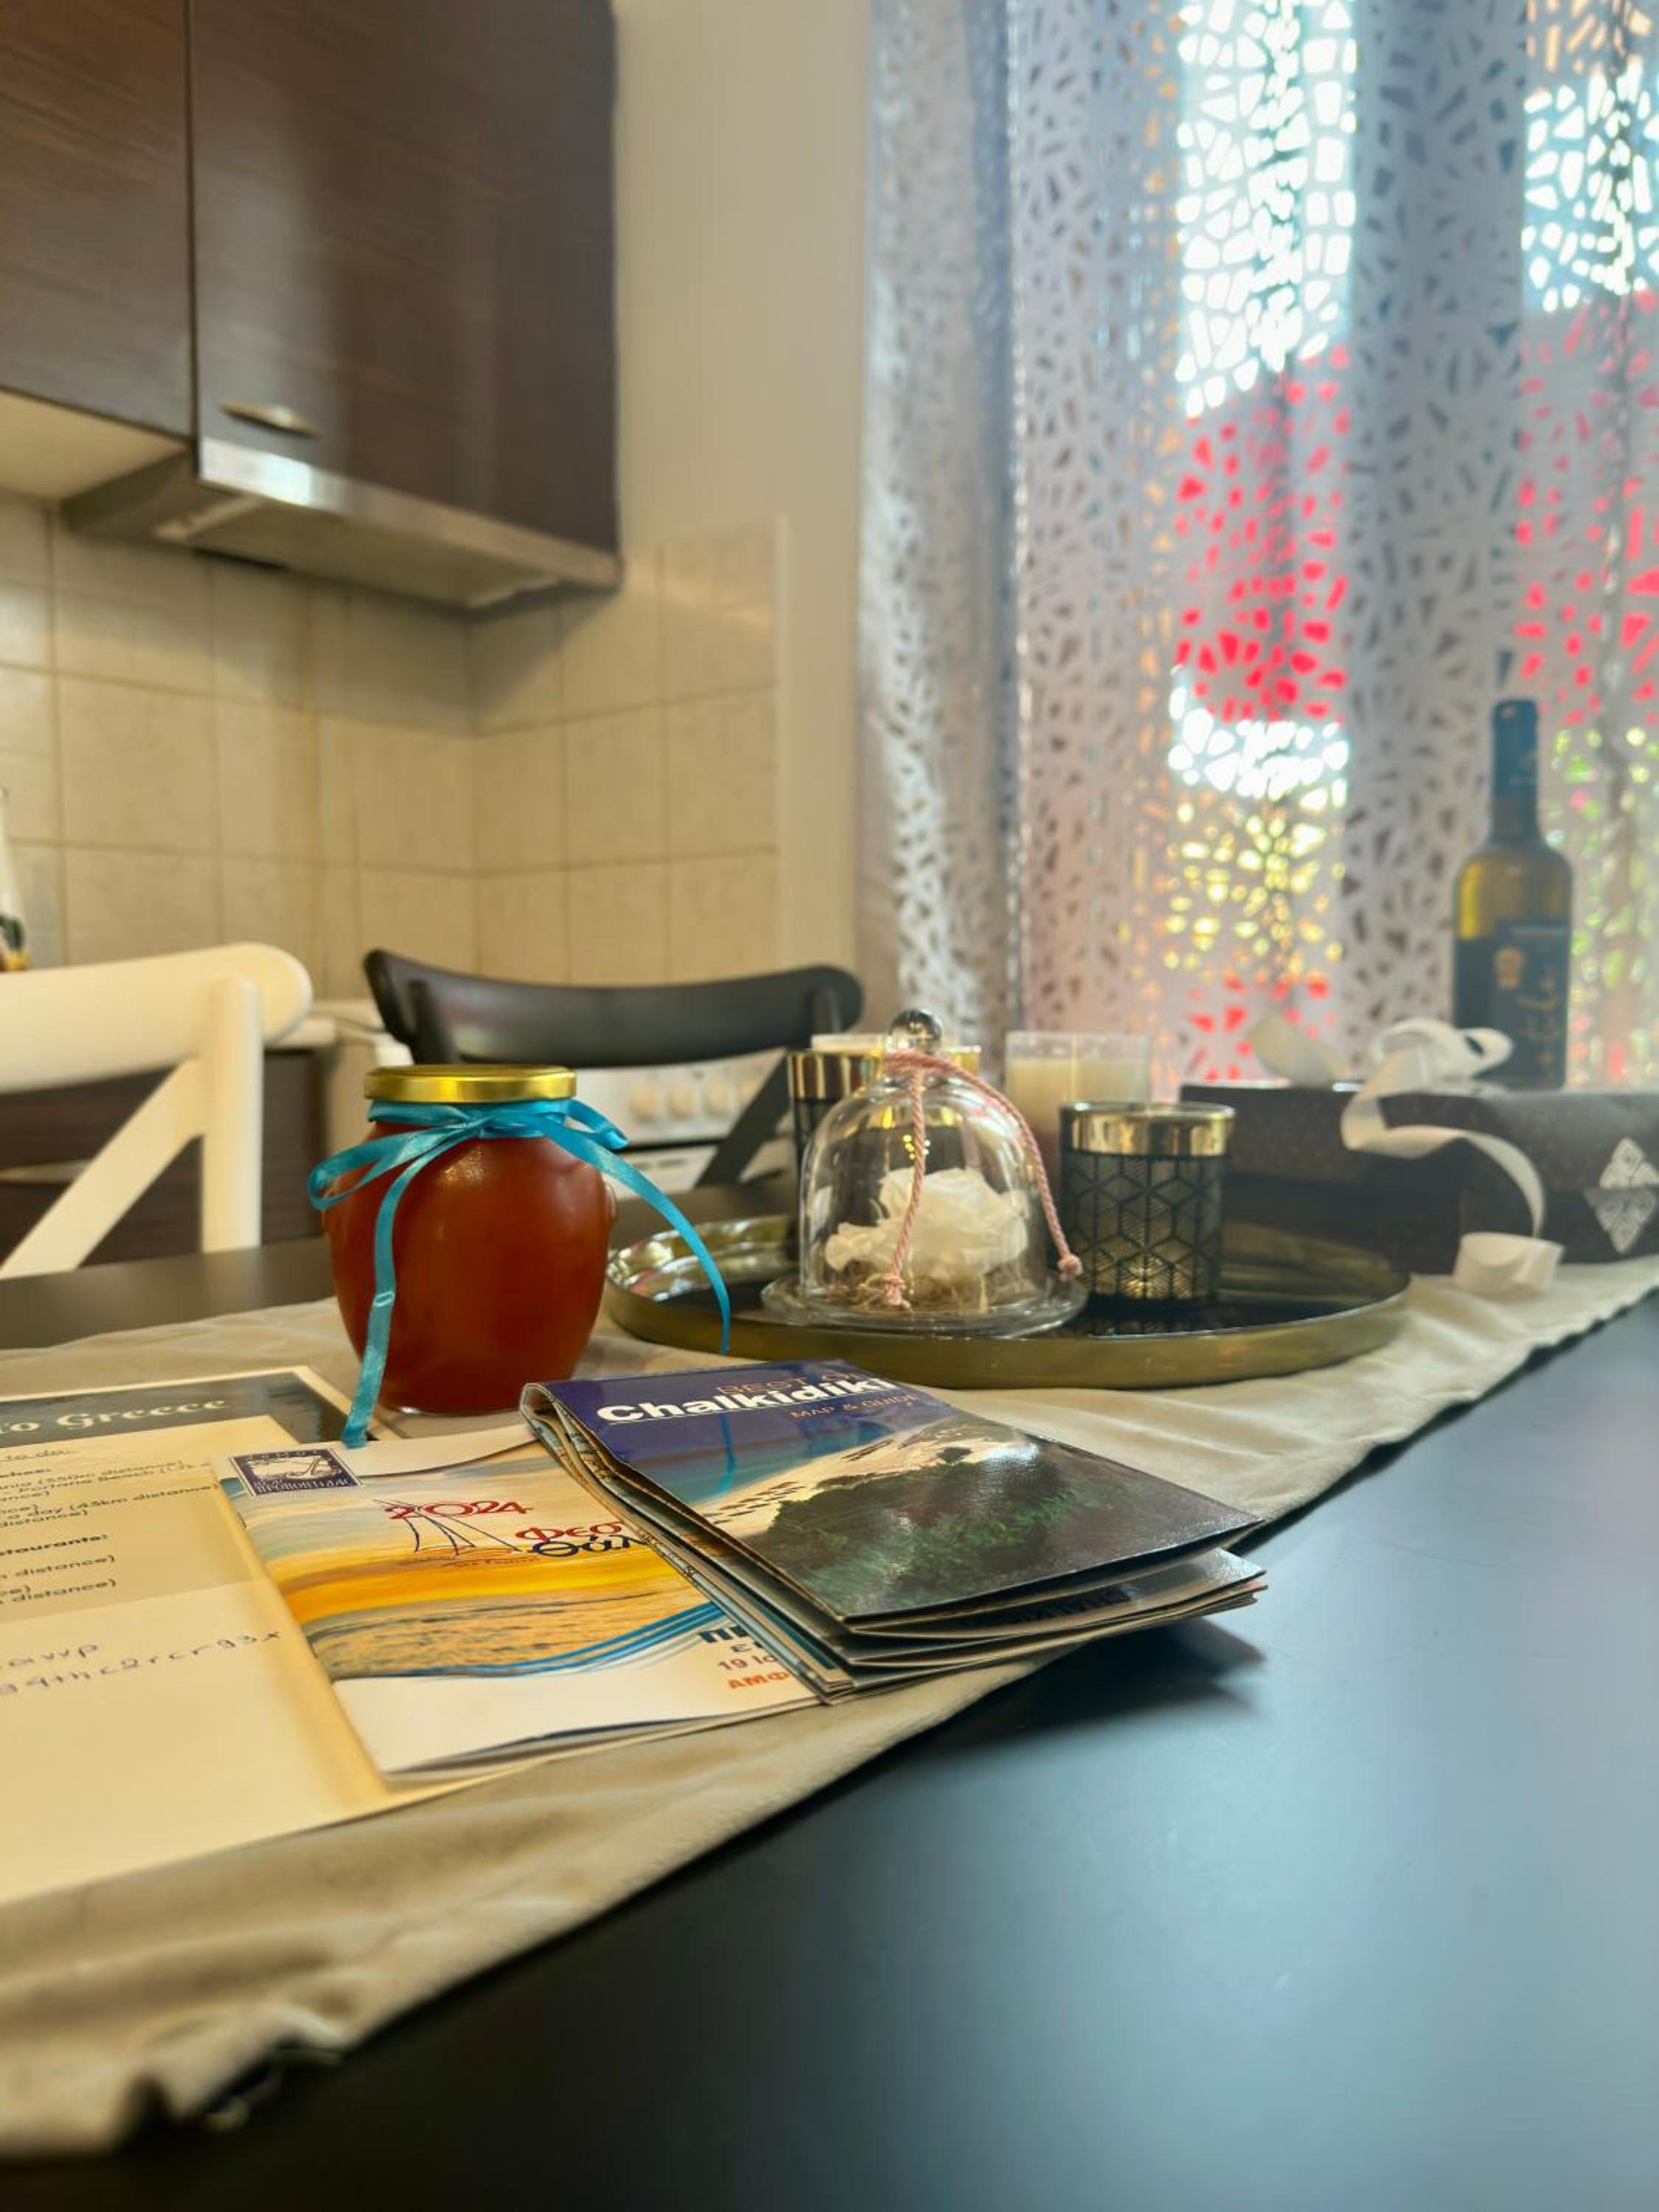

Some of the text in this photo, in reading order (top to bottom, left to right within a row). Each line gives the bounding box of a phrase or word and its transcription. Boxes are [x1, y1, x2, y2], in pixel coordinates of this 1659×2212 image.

[596, 1377, 899, 1422] Chalkidiki
[57, 1400, 225, 1430] Greece
[790, 1405, 835, 1419] MAP
[384, 1500, 535, 1520] 2024
[15, 1554, 115, 1577] distance)
[12, 1579, 116, 1603] distance)
[717, 1658, 749, 1670] 19
